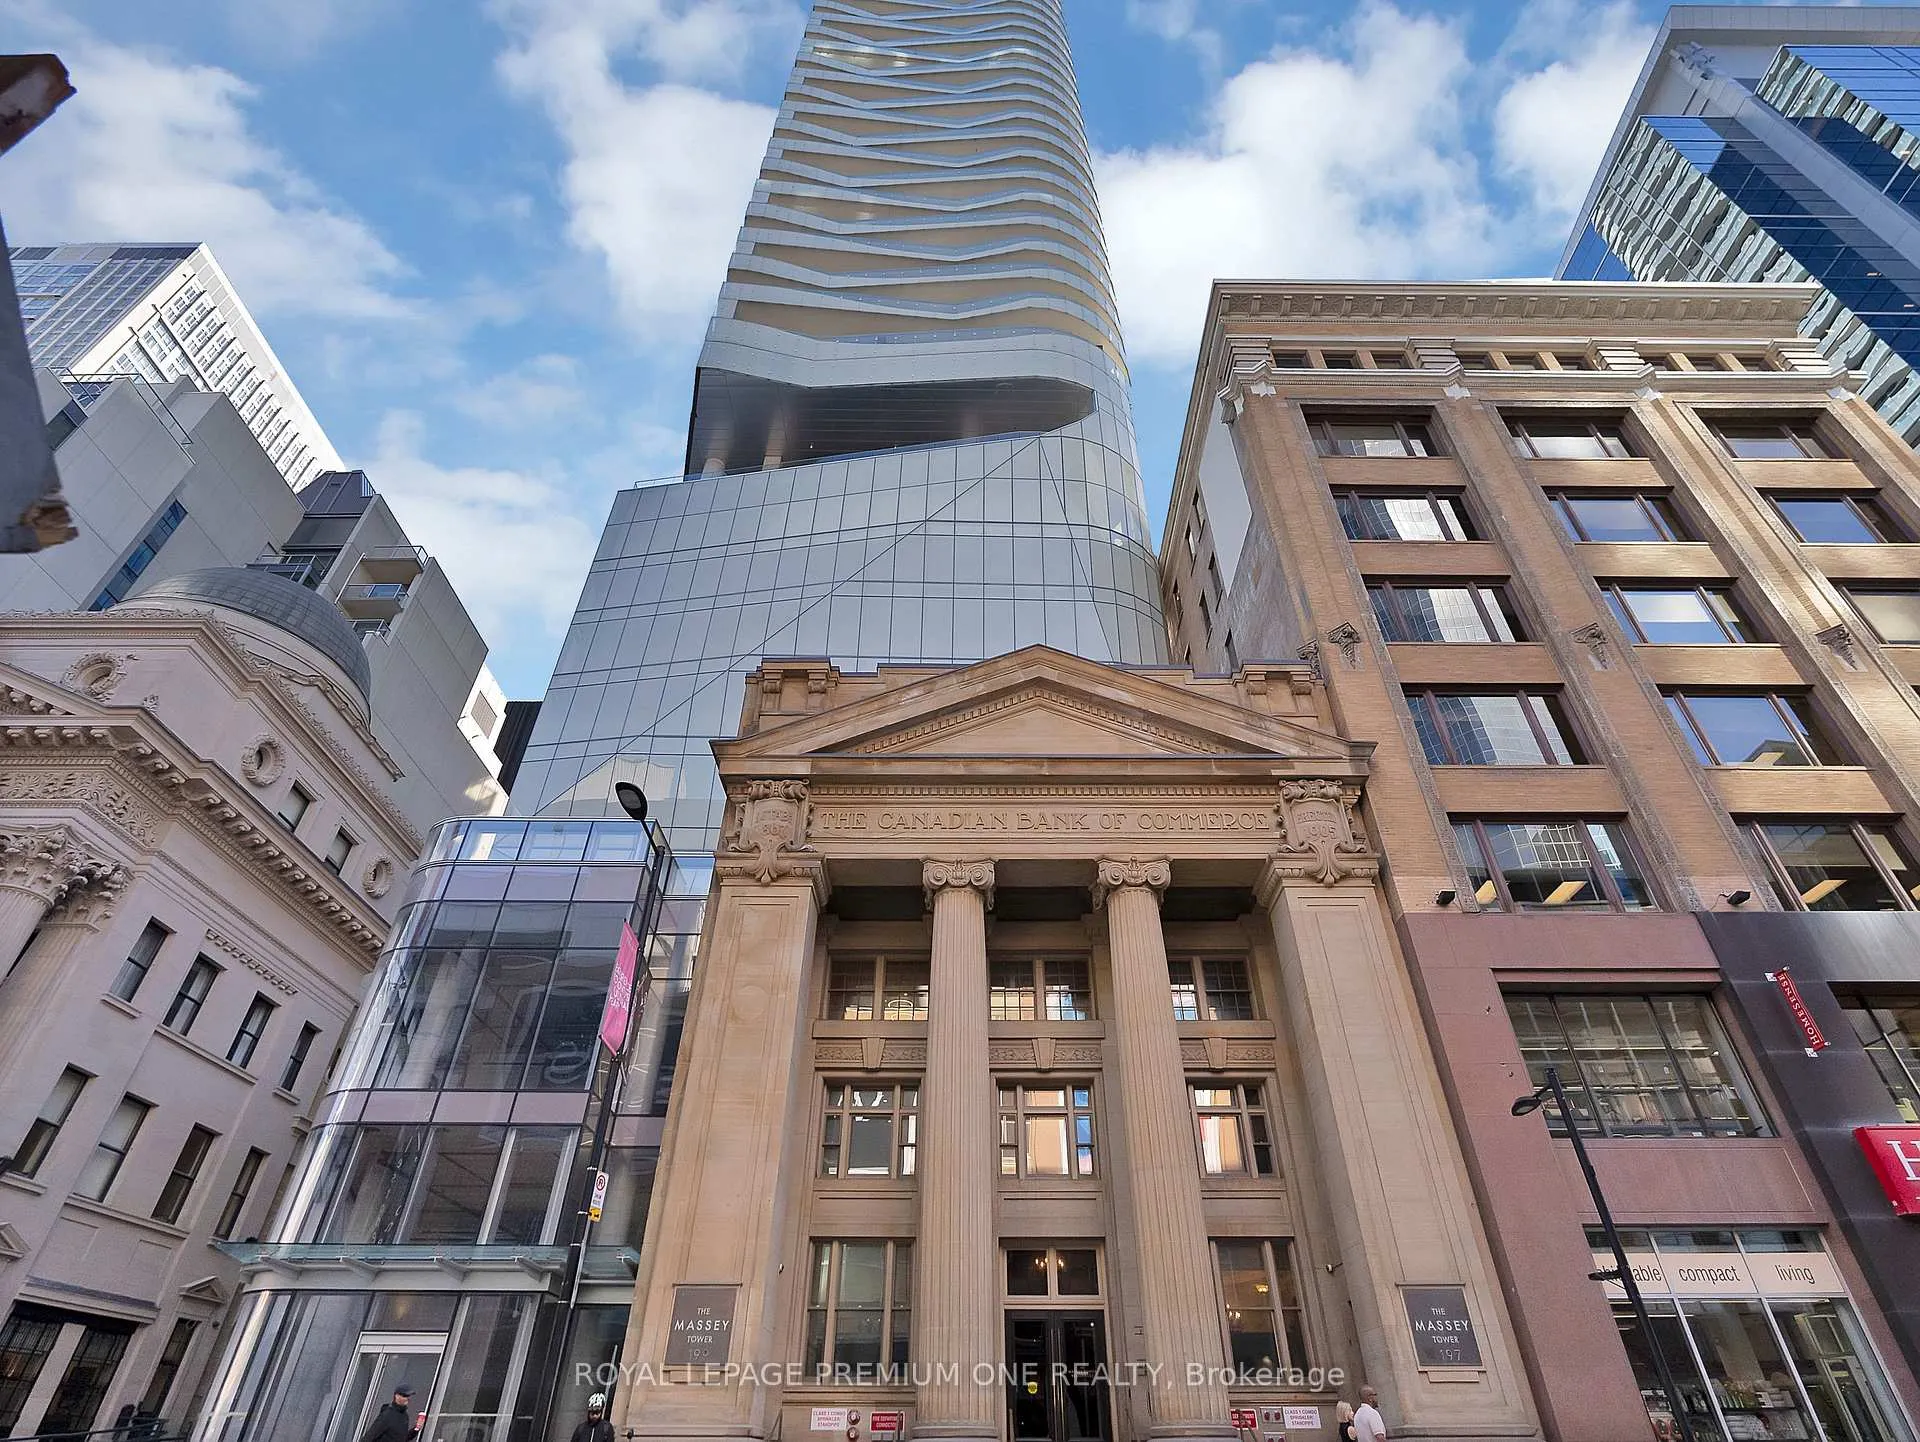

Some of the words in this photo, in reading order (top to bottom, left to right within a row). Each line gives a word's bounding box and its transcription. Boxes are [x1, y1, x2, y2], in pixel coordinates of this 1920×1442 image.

[822, 812, 866, 830] THE
[877, 812, 1008, 830] CANADIAN
[1016, 813, 1090, 830] BANK
[1099, 813, 1127, 830] OF
[1137, 813, 1270, 830] COMMERCE
[1778, 974, 1820, 1044] HOMESENSE
[1678, 1264, 1740, 1284] compact
[1775, 1264, 1815, 1284] living
[697, 1307, 710, 1316] THE
[1431, 1307, 1446, 1316] THE
[674, 1319, 730, 1331] MASSEY
[1415, 1319, 1469, 1331] MASSEY
[687, 1335, 713, 1344] TOWER
[1432, 1335, 1460, 1344] TOWER
[1439, 1349, 1461, 1361] 197
